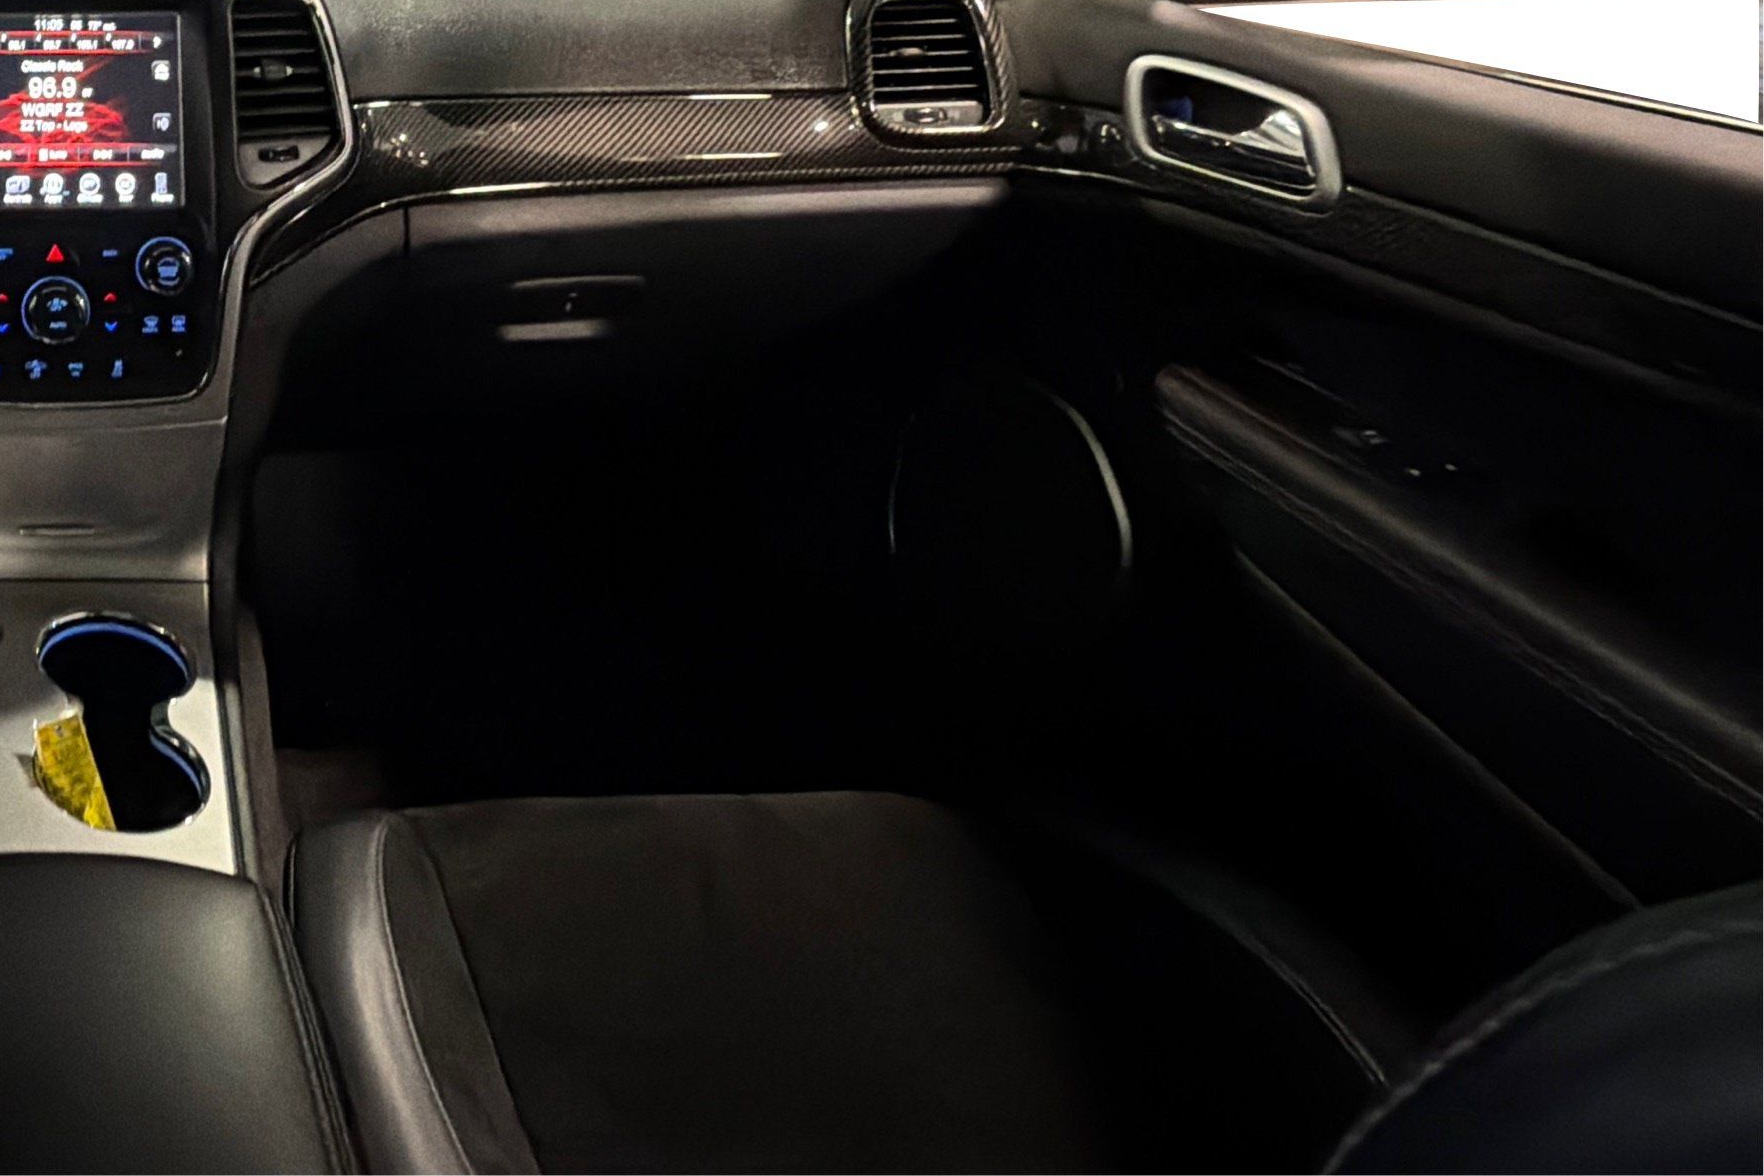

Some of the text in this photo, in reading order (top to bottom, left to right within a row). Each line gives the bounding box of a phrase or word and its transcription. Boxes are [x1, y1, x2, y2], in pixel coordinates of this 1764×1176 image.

[56, 59, 83, 73] Rock
[27, 76, 76, 99] 96.9
[64, 102, 84, 118] ZZ
